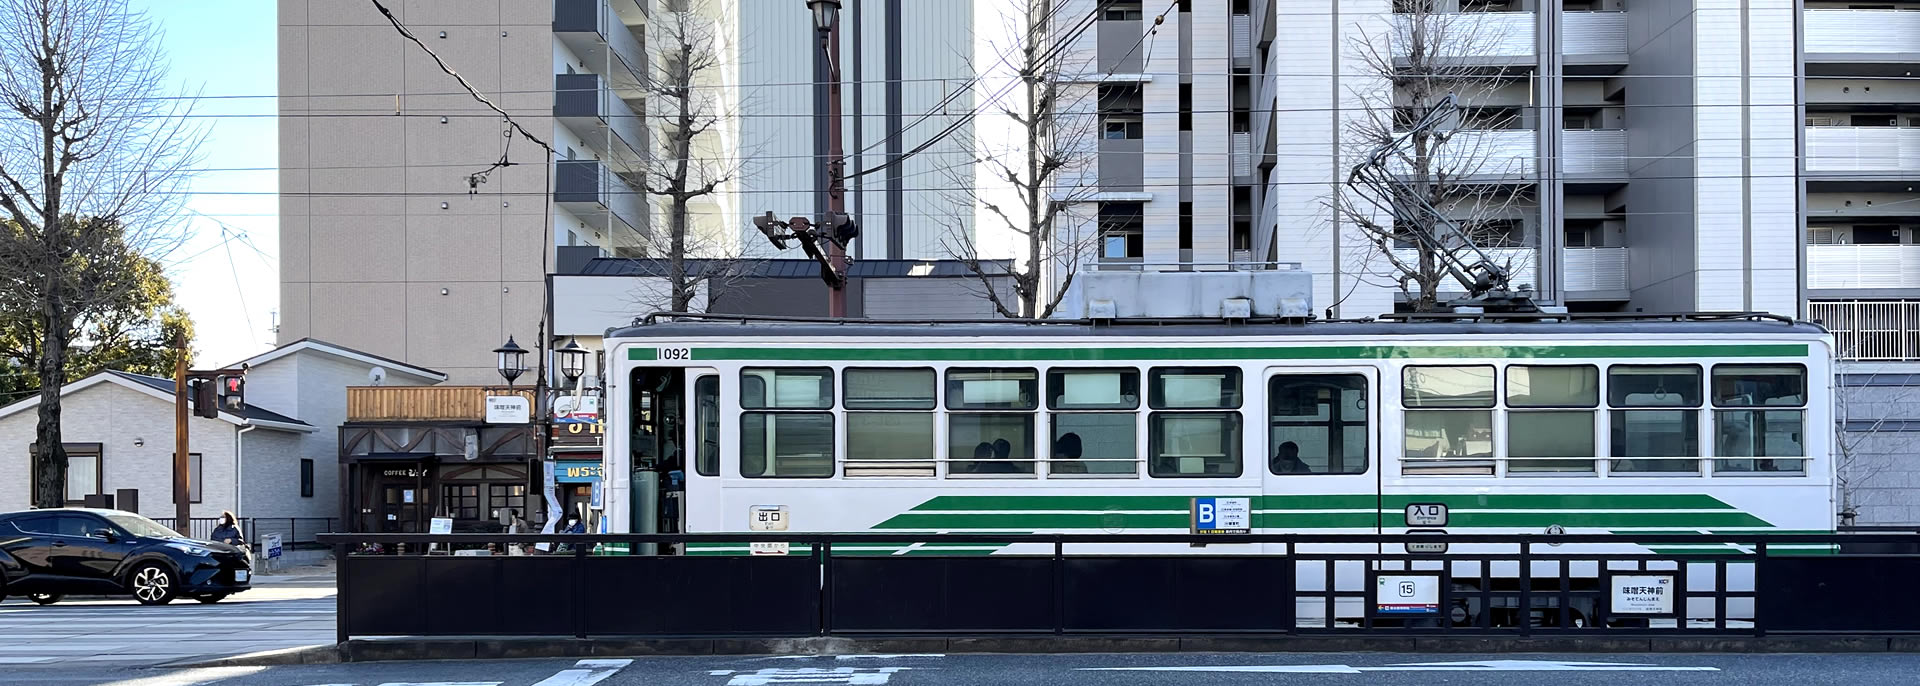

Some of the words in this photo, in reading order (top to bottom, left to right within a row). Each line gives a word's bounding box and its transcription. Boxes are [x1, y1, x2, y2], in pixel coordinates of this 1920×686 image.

[658, 347, 689, 360] 1092
[1199, 503, 1214, 523] B
[1414, 505, 1439, 516] 入口
[758, 512, 780, 522] 出口
[1401, 584, 1413, 594] 15
[1622, 586, 1664, 595] 味噌天神前
